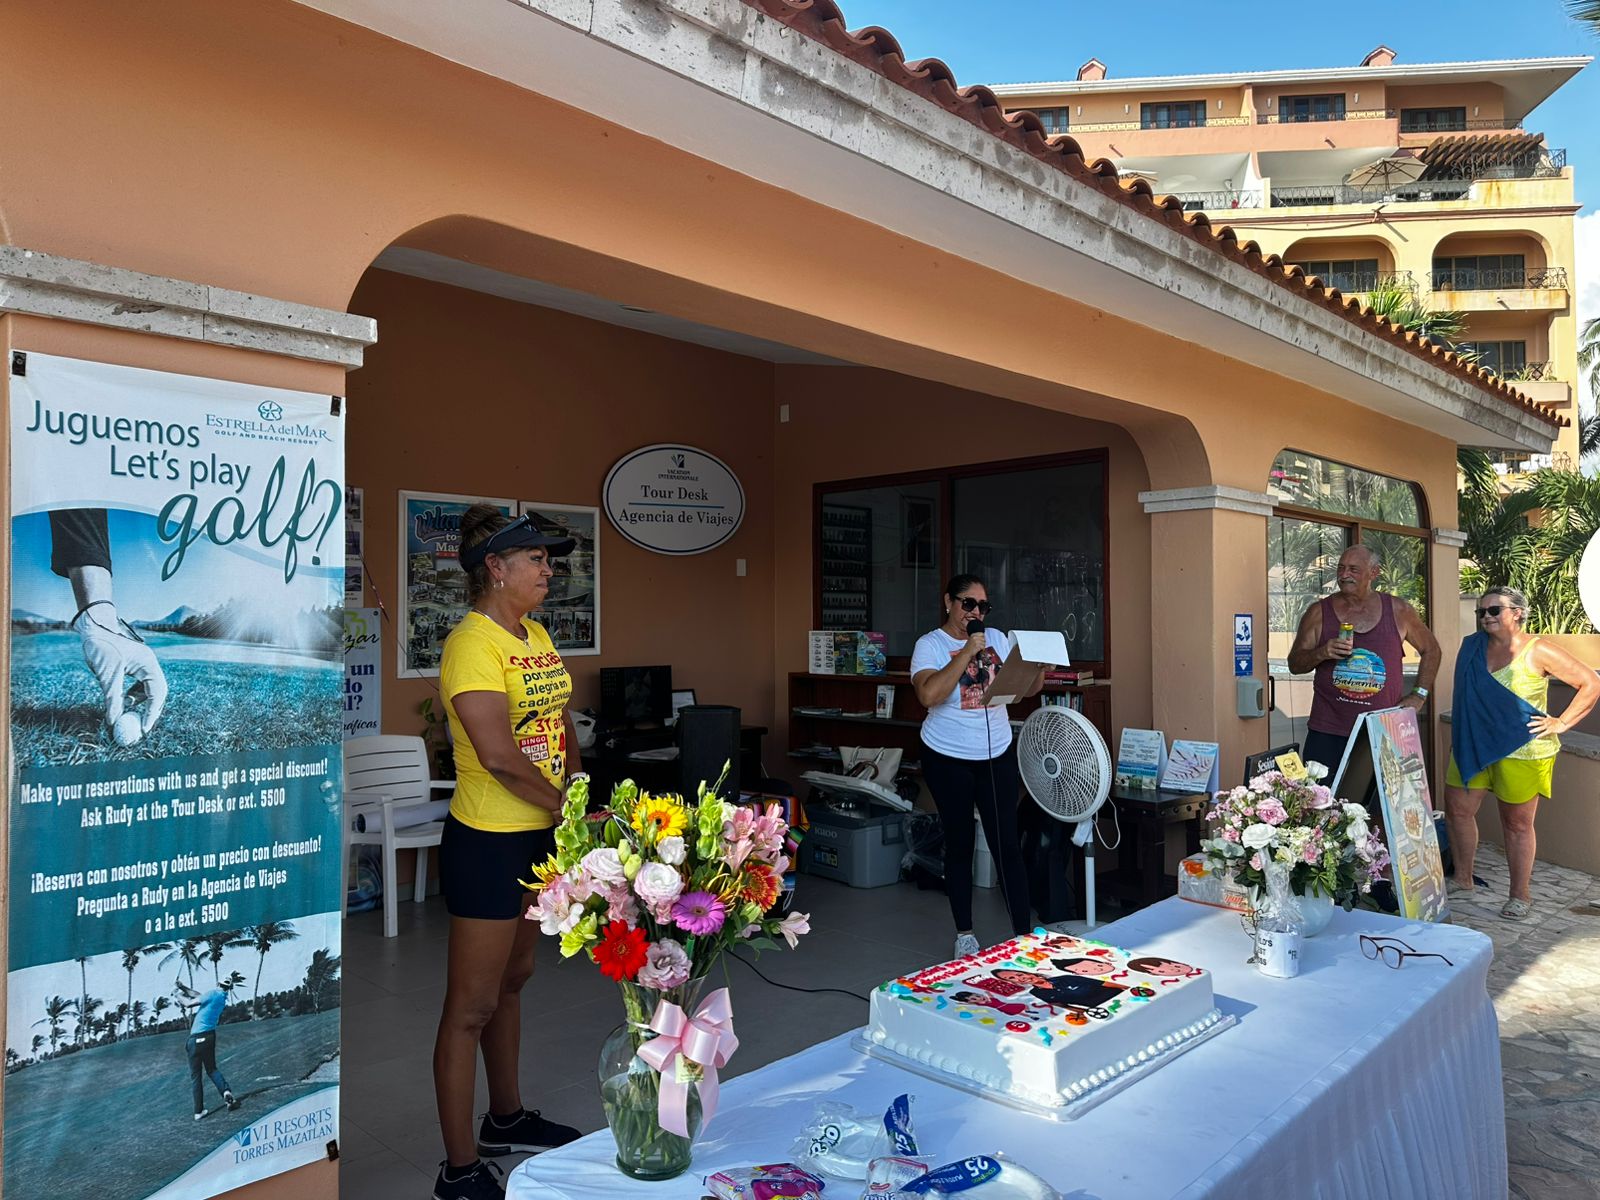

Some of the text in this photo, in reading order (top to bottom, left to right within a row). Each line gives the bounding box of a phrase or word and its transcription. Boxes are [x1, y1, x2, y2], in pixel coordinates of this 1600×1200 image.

[27, 400, 201, 447] Juguemos
[206, 413, 334, 443] ESTRELLA del MAR
[214, 429, 237, 438] GOLF
[258, 434, 286, 443] BEACH
[287, 437, 319, 446] RESORT
[110, 445, 251, 494] Let's play
[641, 484, 709, 501] Tour Desk
[156, 454, 343, 584] golf?
[618, 508, 734, 527] Agencia de Viajes
[446, 533, 457, 541] to
[509, 651, 561, 670] Gracias
[522, 671, 542, 685] por
[560, 679, 568, 688] en
[1333, 674, 1384, 689] Bahamas
[518, 696, 549, 709] cada
[521, 736, 546, 746] BINGO
[21, 758, 329, 806] Make your reservations with us and get a special discount!
[81, 787, 286, 828] Ask Rudy at the Tour Desk or ext. 5500
[31, 835, 322, 894] ¡Reserva con nosotros y obtén un precio con descuento!
[77, 867, 287, 918] Pregunta a Rudy en la Agencia de Viajes
[145, 901, 229, 934] o a la ext. 5500
[253, 1107, 332, 1142] VI RESORTS
[233, 1123, 333, 1164] TORRES MAZATLAN
[964, 1155, 989, 1177] 25
